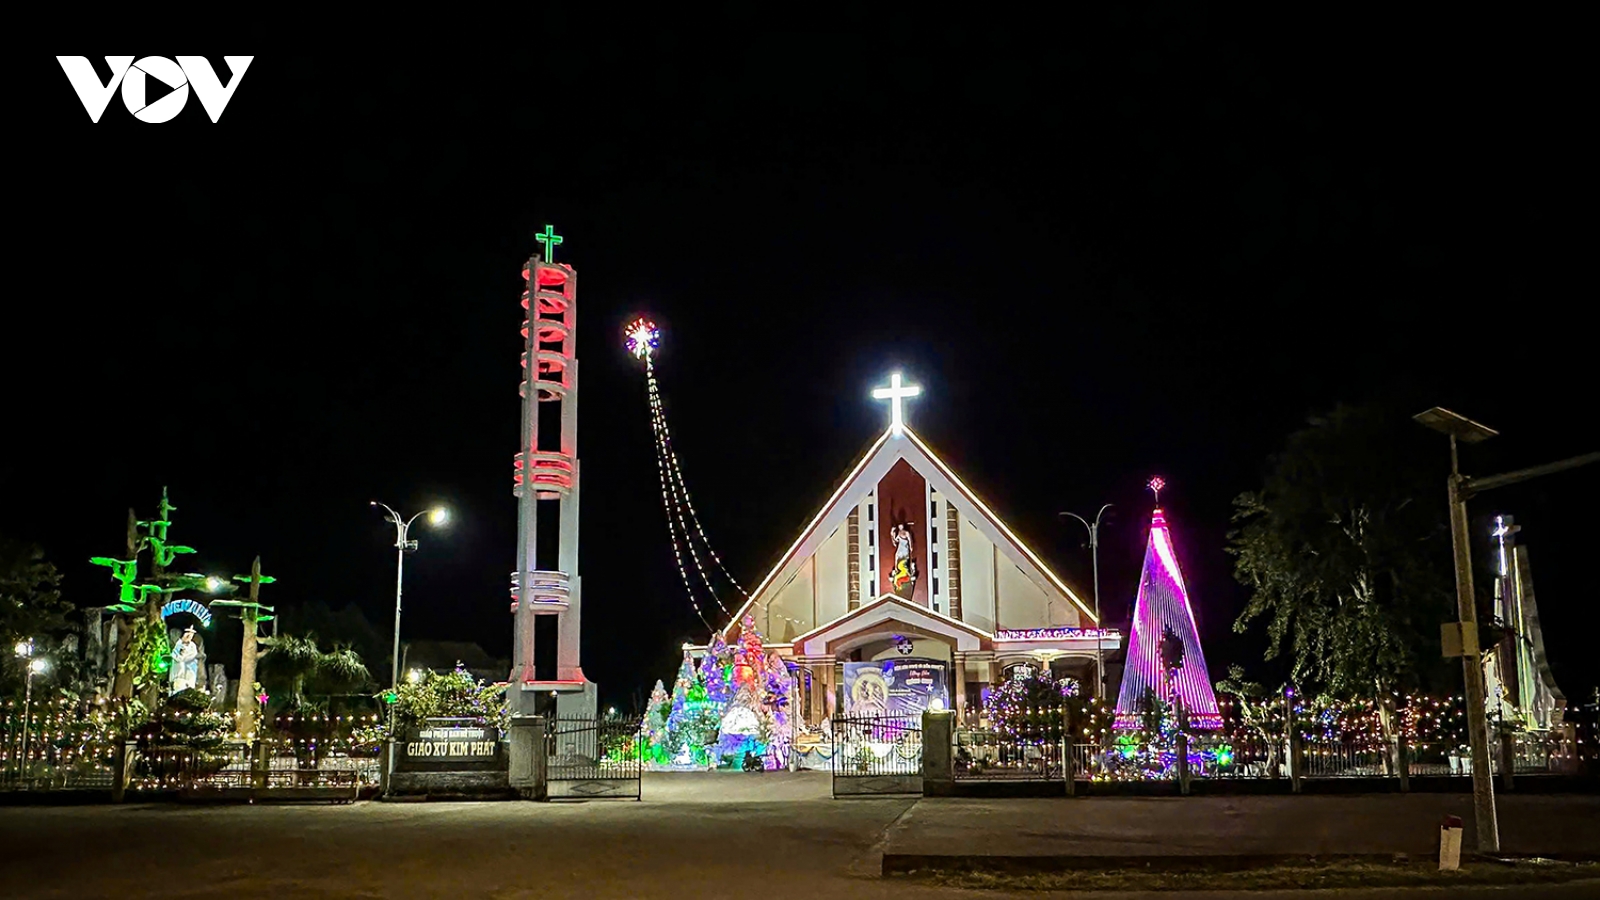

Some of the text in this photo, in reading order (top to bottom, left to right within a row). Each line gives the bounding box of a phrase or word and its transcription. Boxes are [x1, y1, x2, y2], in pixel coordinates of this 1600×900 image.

[407, 738, 496, 757] GIÁO XỨ KIM PHÁT
